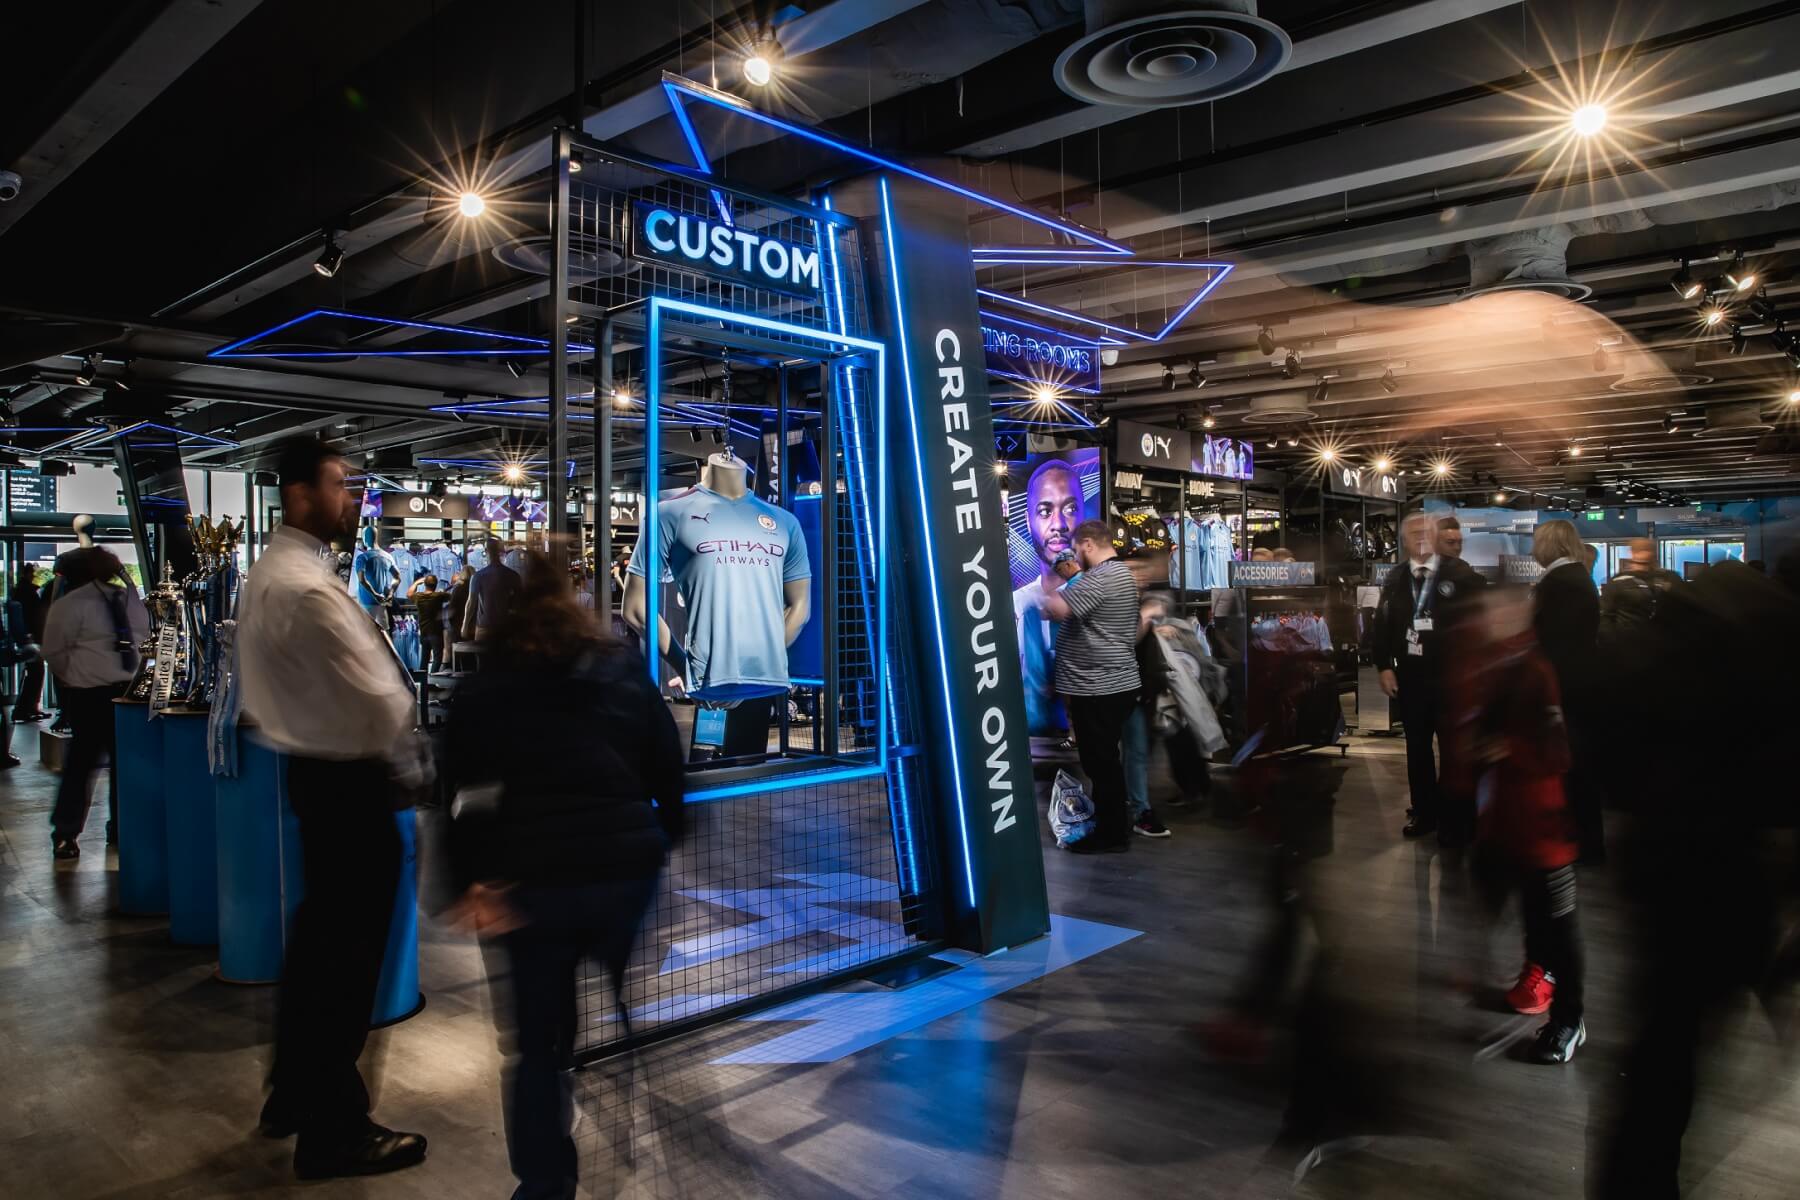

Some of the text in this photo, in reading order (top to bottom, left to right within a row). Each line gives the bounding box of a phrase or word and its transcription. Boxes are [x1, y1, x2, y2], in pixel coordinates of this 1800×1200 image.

[645, 209, 820, 289] CUSTOM
[980, 326, 1090, 373] ING ROOMS
[1115, 471, 1143, 489] AWAY
[1189, 480, 1215, 497] HOME
[696, 539, 785, 558] ETIHAD
[715, 555, 770, 567] AIRWAYS
[935, 328, 1017, 834] CREATE YOUR OWN
[1233, 566, 1289, 580] ACCESSORIES
[152, 622, 176, 711] Emirates FLY BETT
